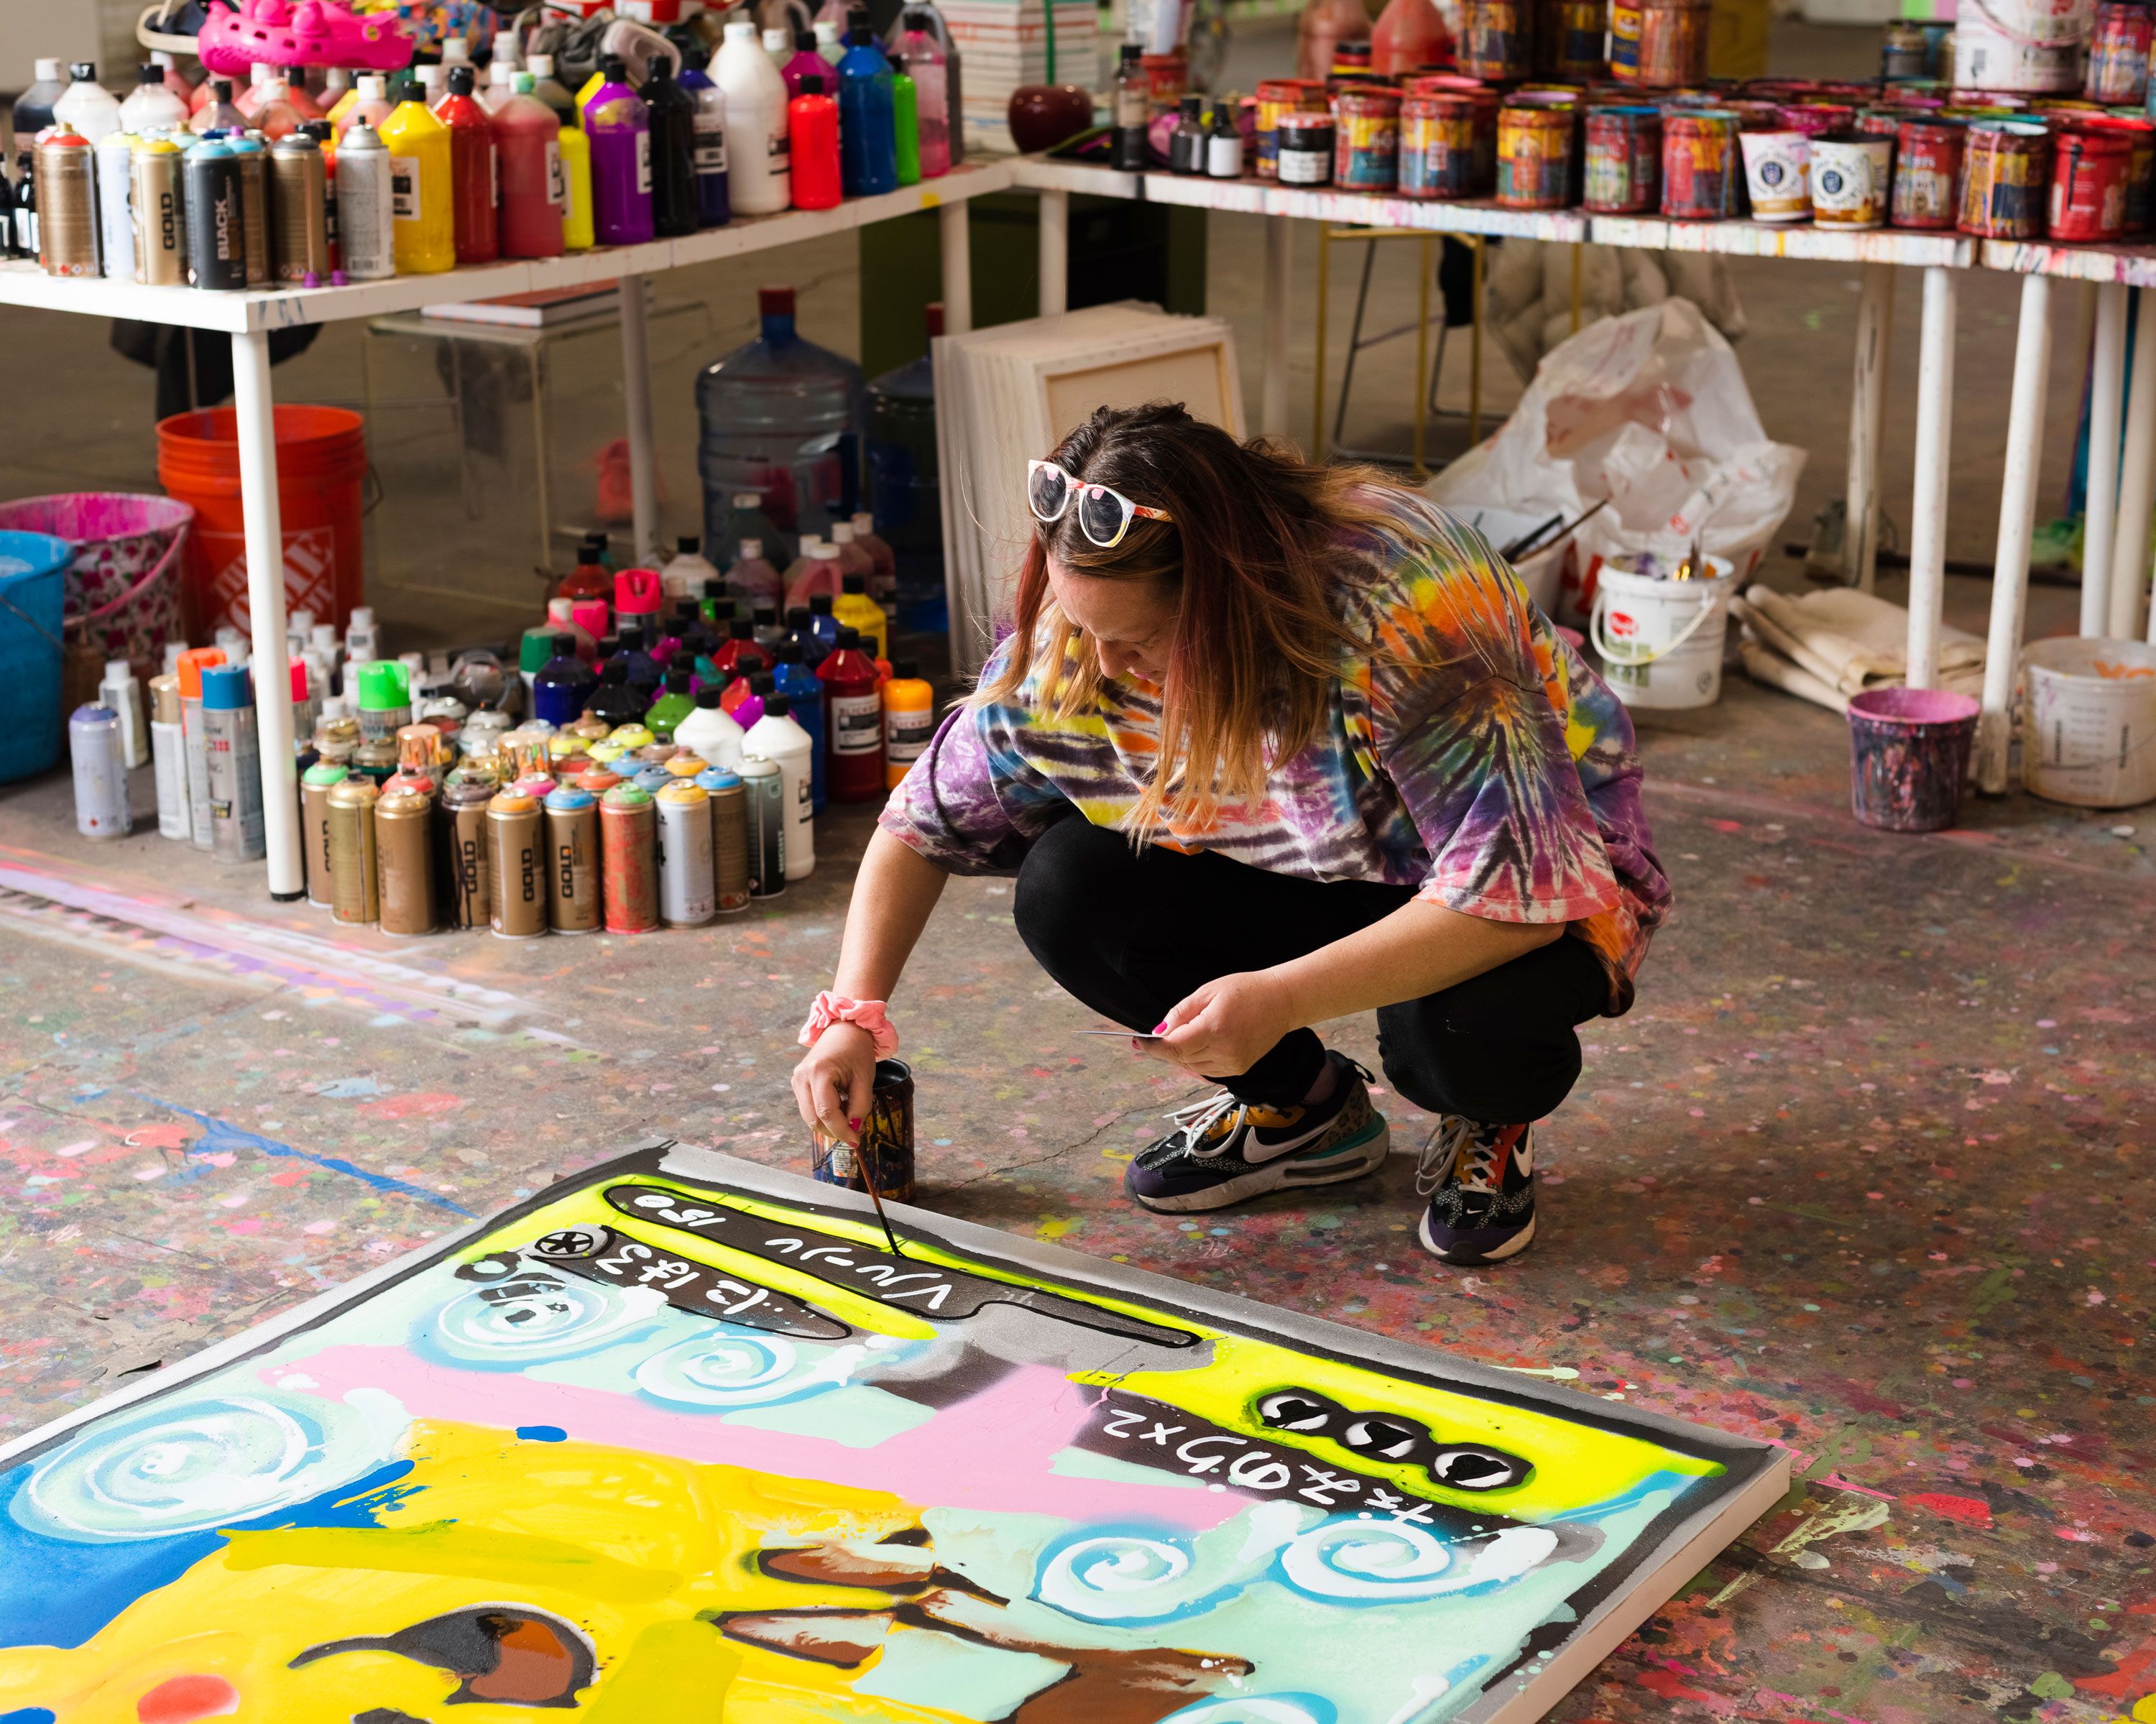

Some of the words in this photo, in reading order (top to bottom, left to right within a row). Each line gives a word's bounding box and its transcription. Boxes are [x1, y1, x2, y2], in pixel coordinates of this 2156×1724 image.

[162, 193, 174, 249] GOLD
[216, 198, 230, 260] BLACK
[464, 840, 477, 894] GOLD
[521, 848, 534, 902] GOLD
[560, 845, 573, 898] GOLD
